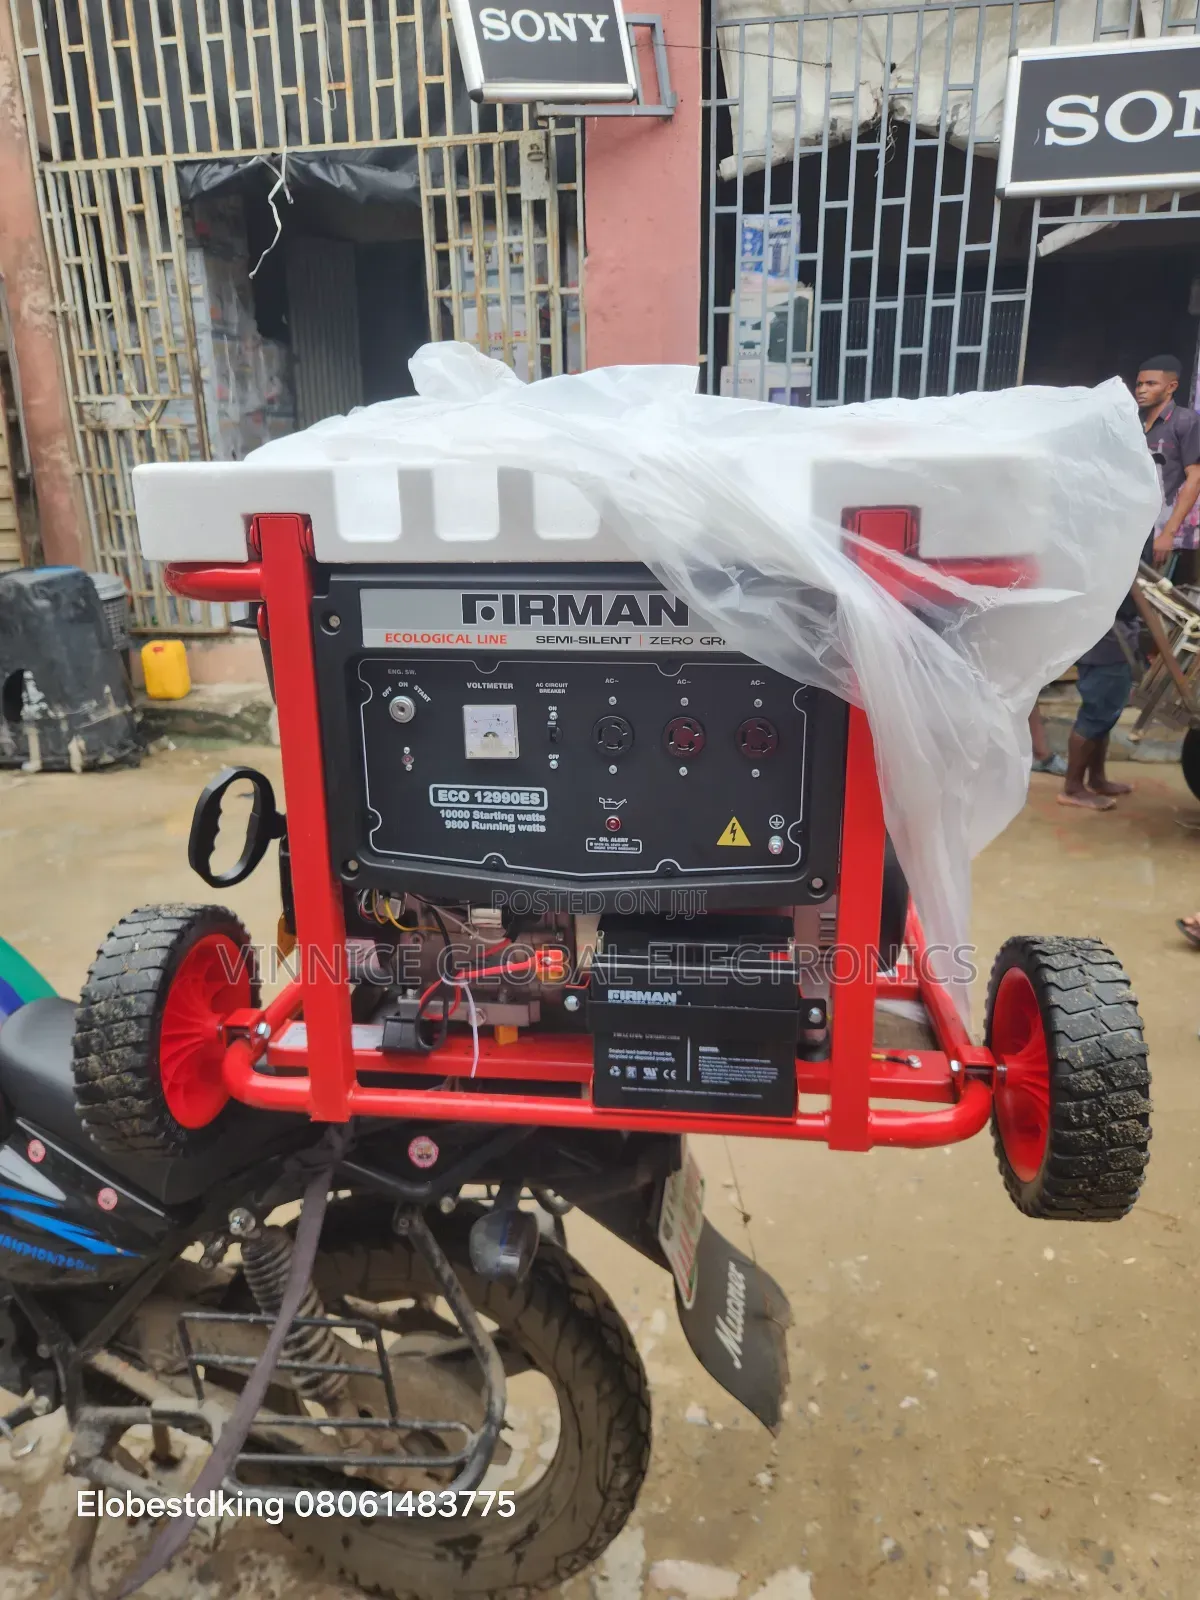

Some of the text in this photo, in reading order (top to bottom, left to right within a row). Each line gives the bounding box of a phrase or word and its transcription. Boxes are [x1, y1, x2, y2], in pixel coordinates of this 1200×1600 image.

[479, 7, 609, 43] SONY
[460, 592, 689, 627] FIRMAN
[384, 632, 508, 645] ECOLOGICAL LINE
[535, 635, 632, 646] SEMI-SILENT
[649, 636, 694, 646] ZERO
[388, 668, 403, 676] ENG.
[382, 686, 393, 698] OFF
[466, 682, 514, 690] VOLTMETER
[413, 685, 432, 703] START
[437, 789, 541, 805] ECO 12990ES
[440, 809, 546, 822] 10000 Starting watts
[445, 820, 547, 833] 9800 Running watts
